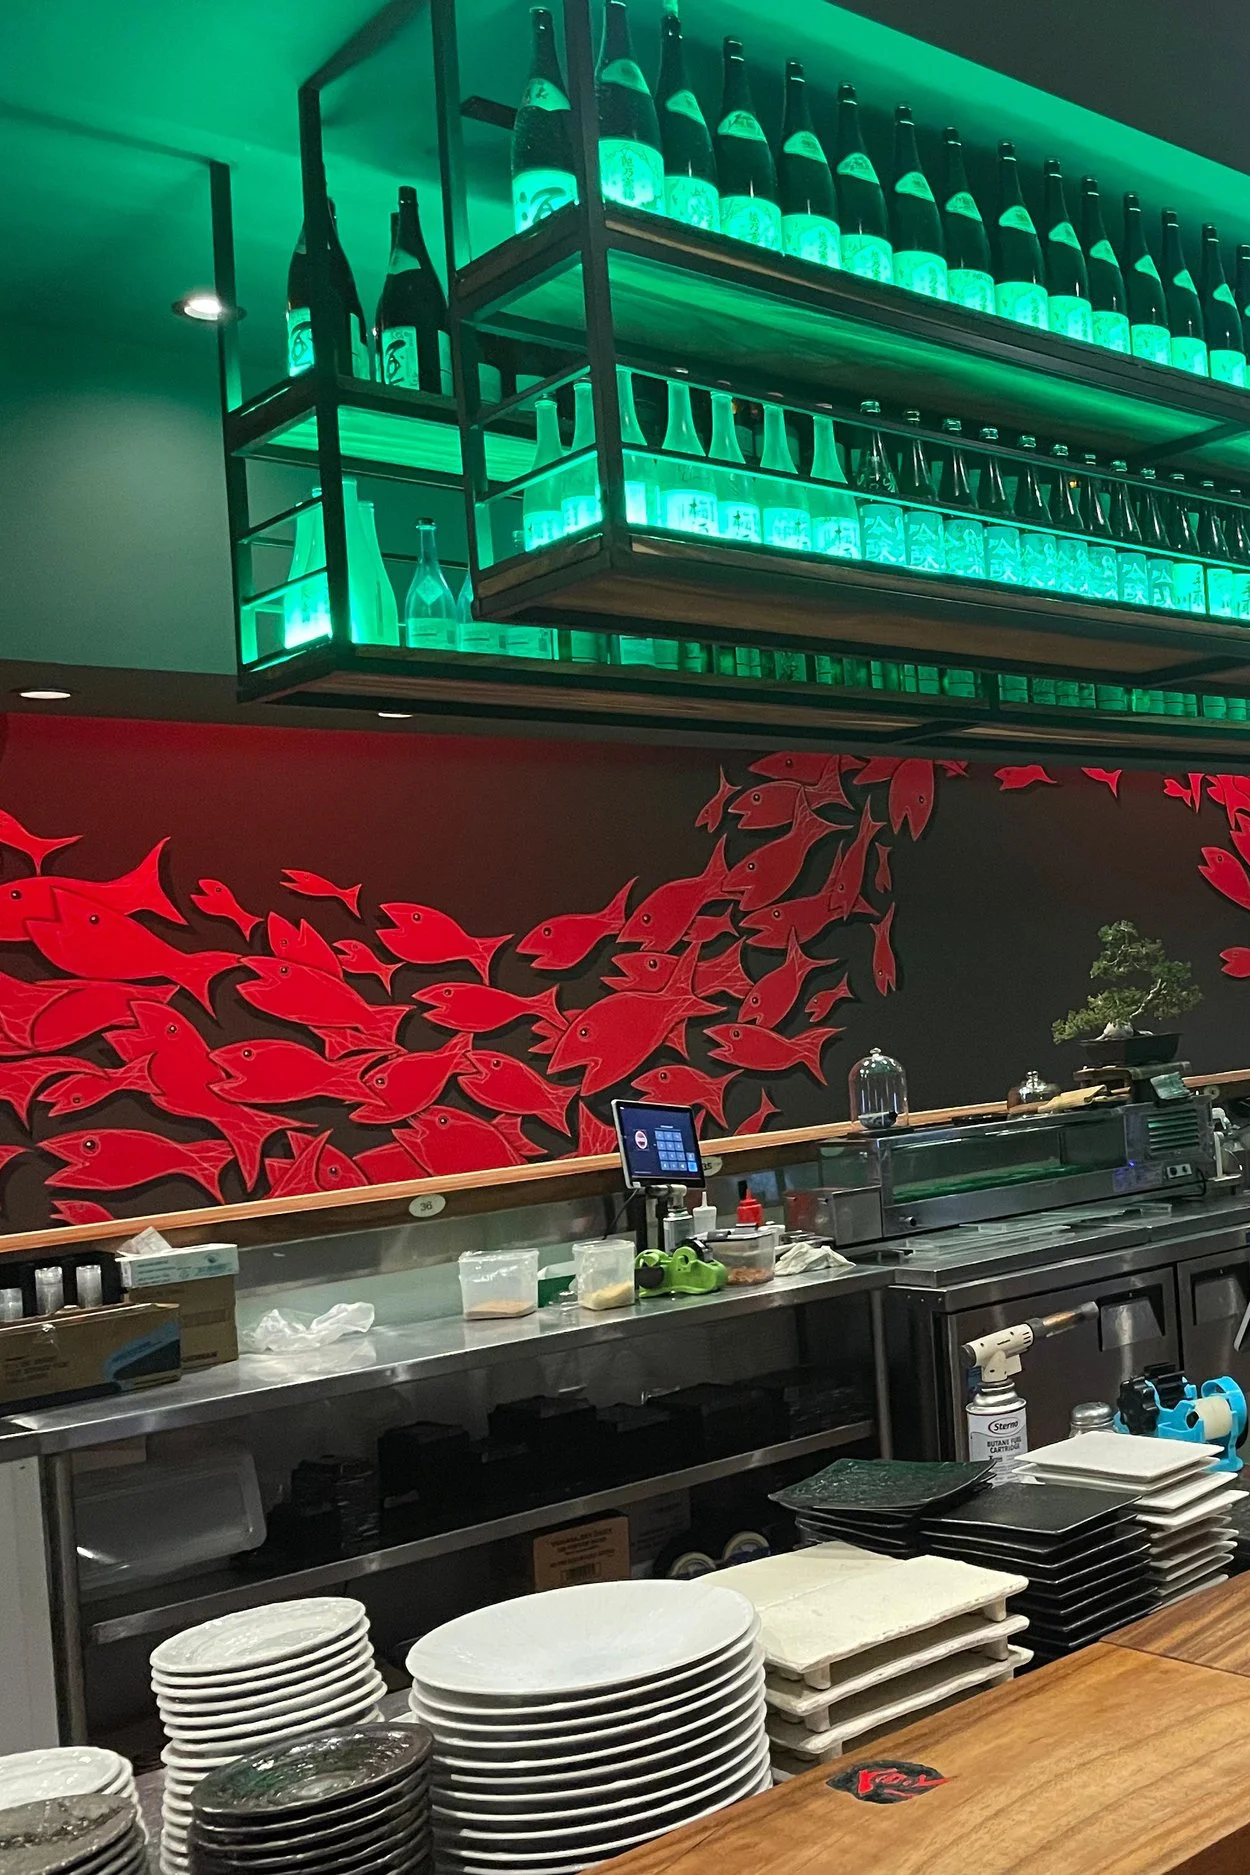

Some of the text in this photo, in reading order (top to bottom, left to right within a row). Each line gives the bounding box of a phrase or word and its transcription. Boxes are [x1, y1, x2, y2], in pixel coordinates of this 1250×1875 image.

[419, 1200, 433, 1212] 36
[993, 1421, 1019, 1431] Sterno
[987, 1439, 1009, 1447] BUTANE
[989, 1443, 1020, 1454] CARTRIDGE
